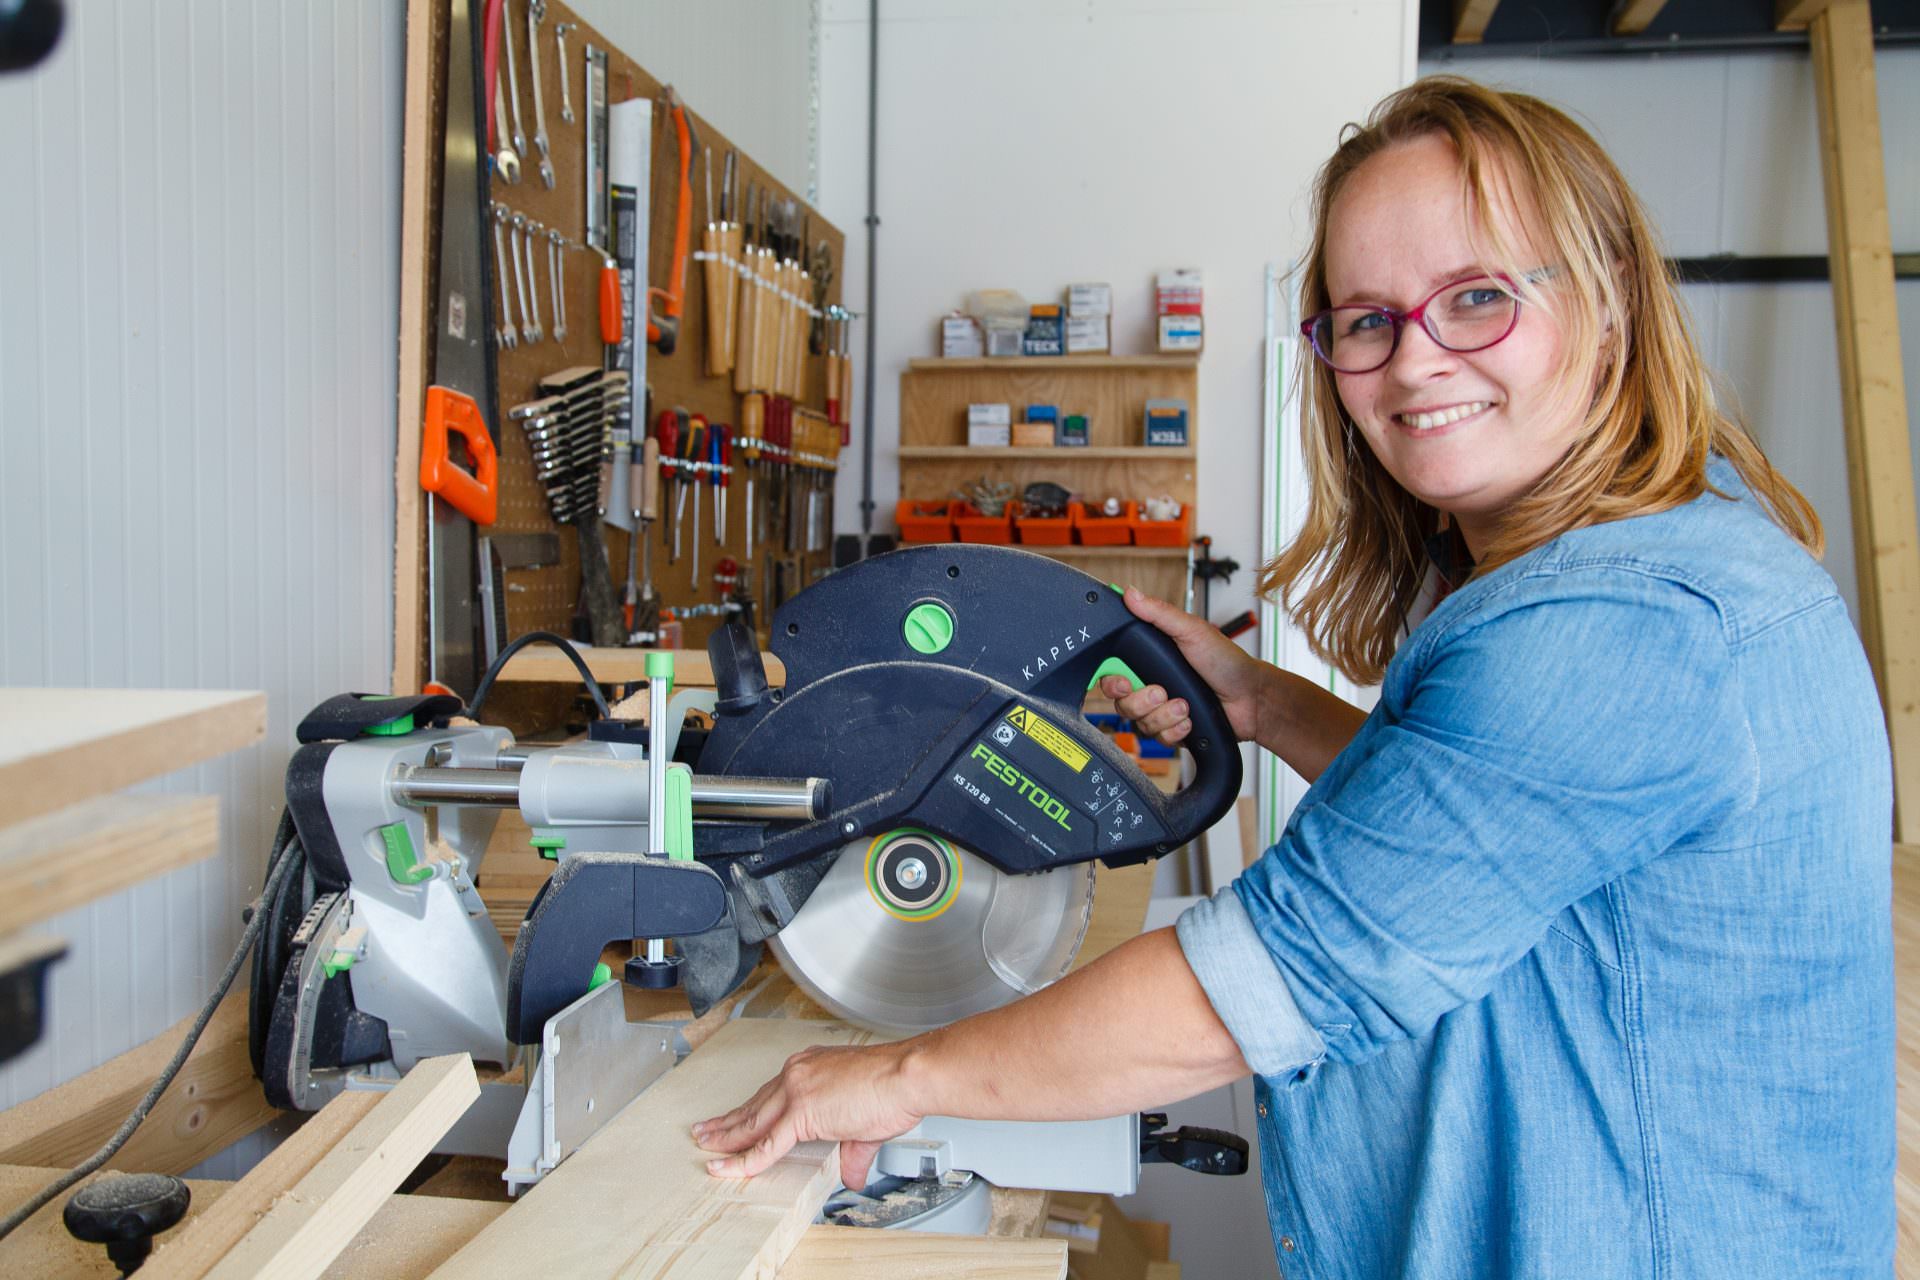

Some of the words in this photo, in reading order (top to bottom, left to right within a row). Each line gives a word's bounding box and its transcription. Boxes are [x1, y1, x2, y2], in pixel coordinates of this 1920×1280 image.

[1022, 626, 1091, 681] KAPEX
[953, 773, 966, 786] KS
[965, 782, 980, 797] 120
[971, 743, 1072, 832] FESTOOL
[1113, 816, 1123, 829] R
